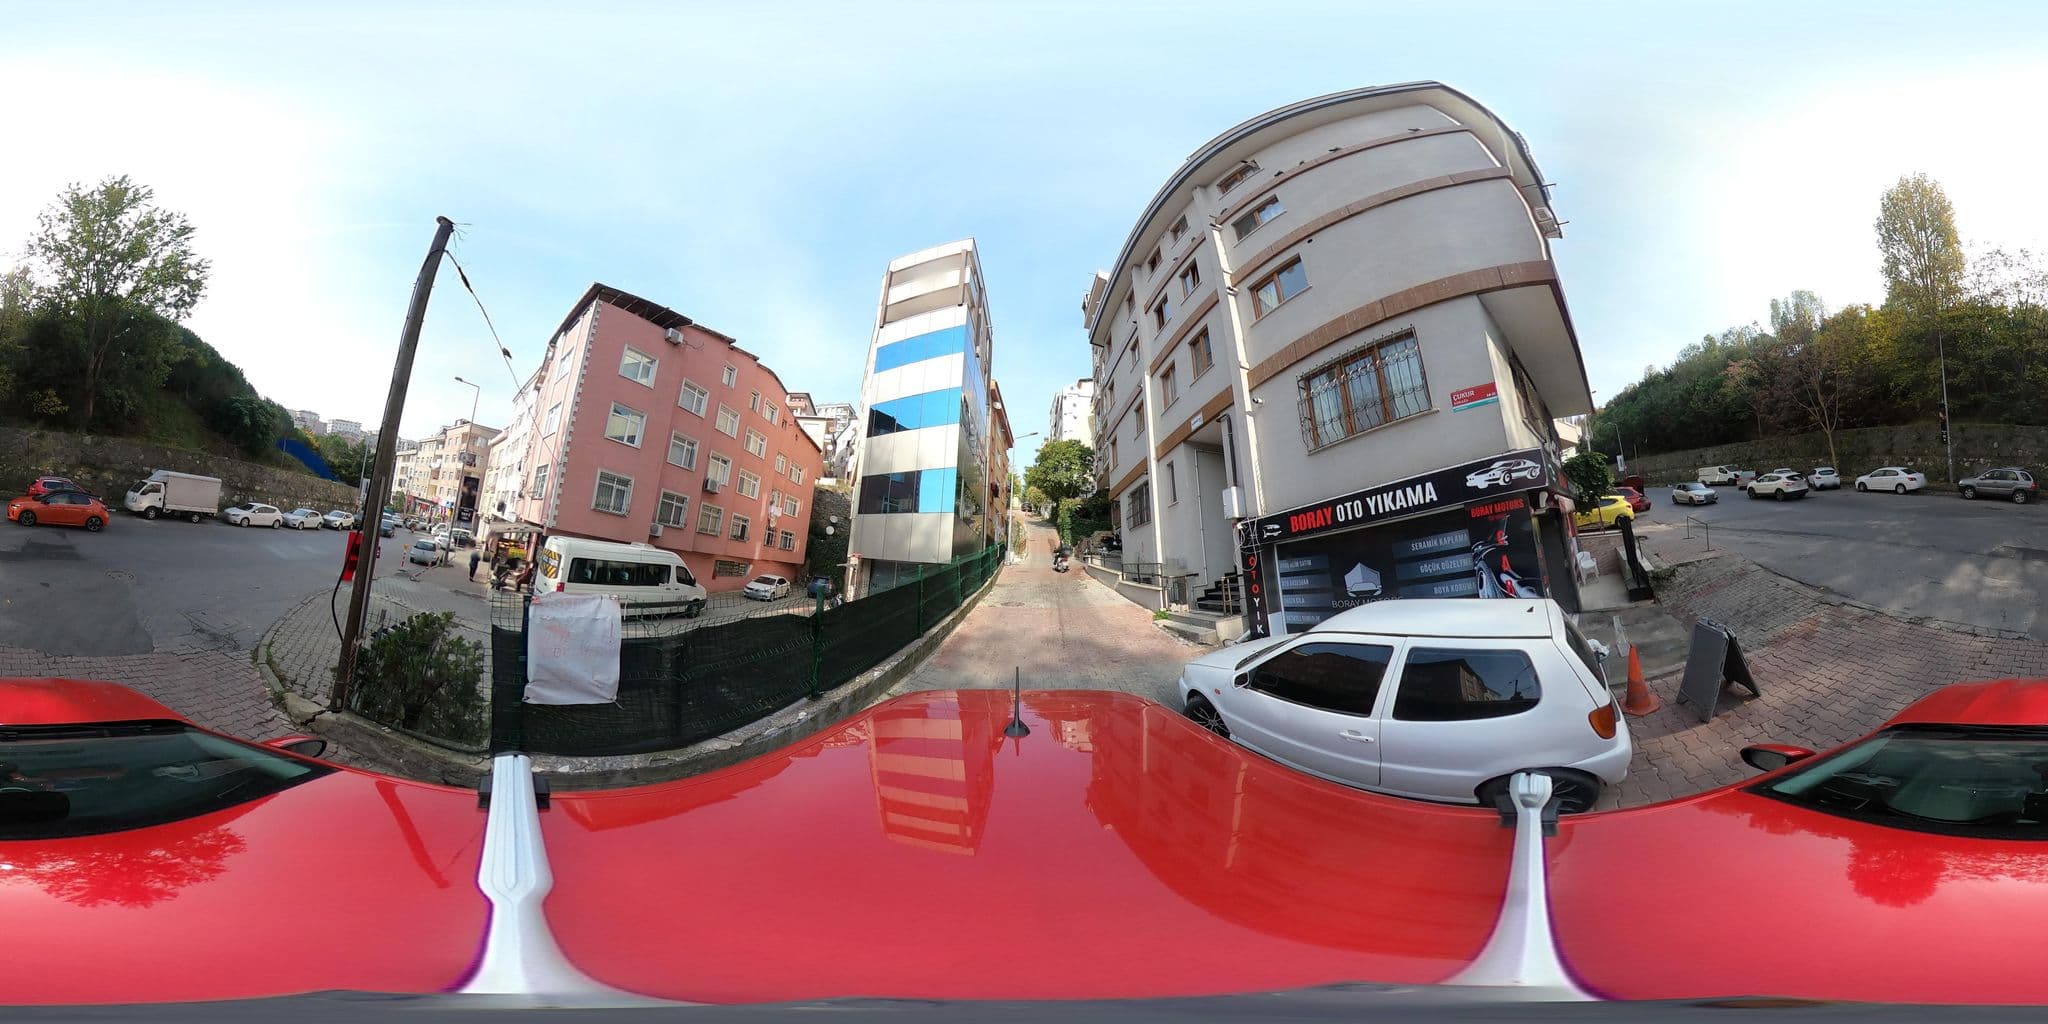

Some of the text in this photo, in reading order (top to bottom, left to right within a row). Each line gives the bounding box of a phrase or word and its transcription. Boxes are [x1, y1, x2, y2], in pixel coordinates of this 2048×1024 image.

[1290, 481, 1438, 533] BORAY OTO YIKAMA
[1494, 498, 1525, 513] MOTORS
